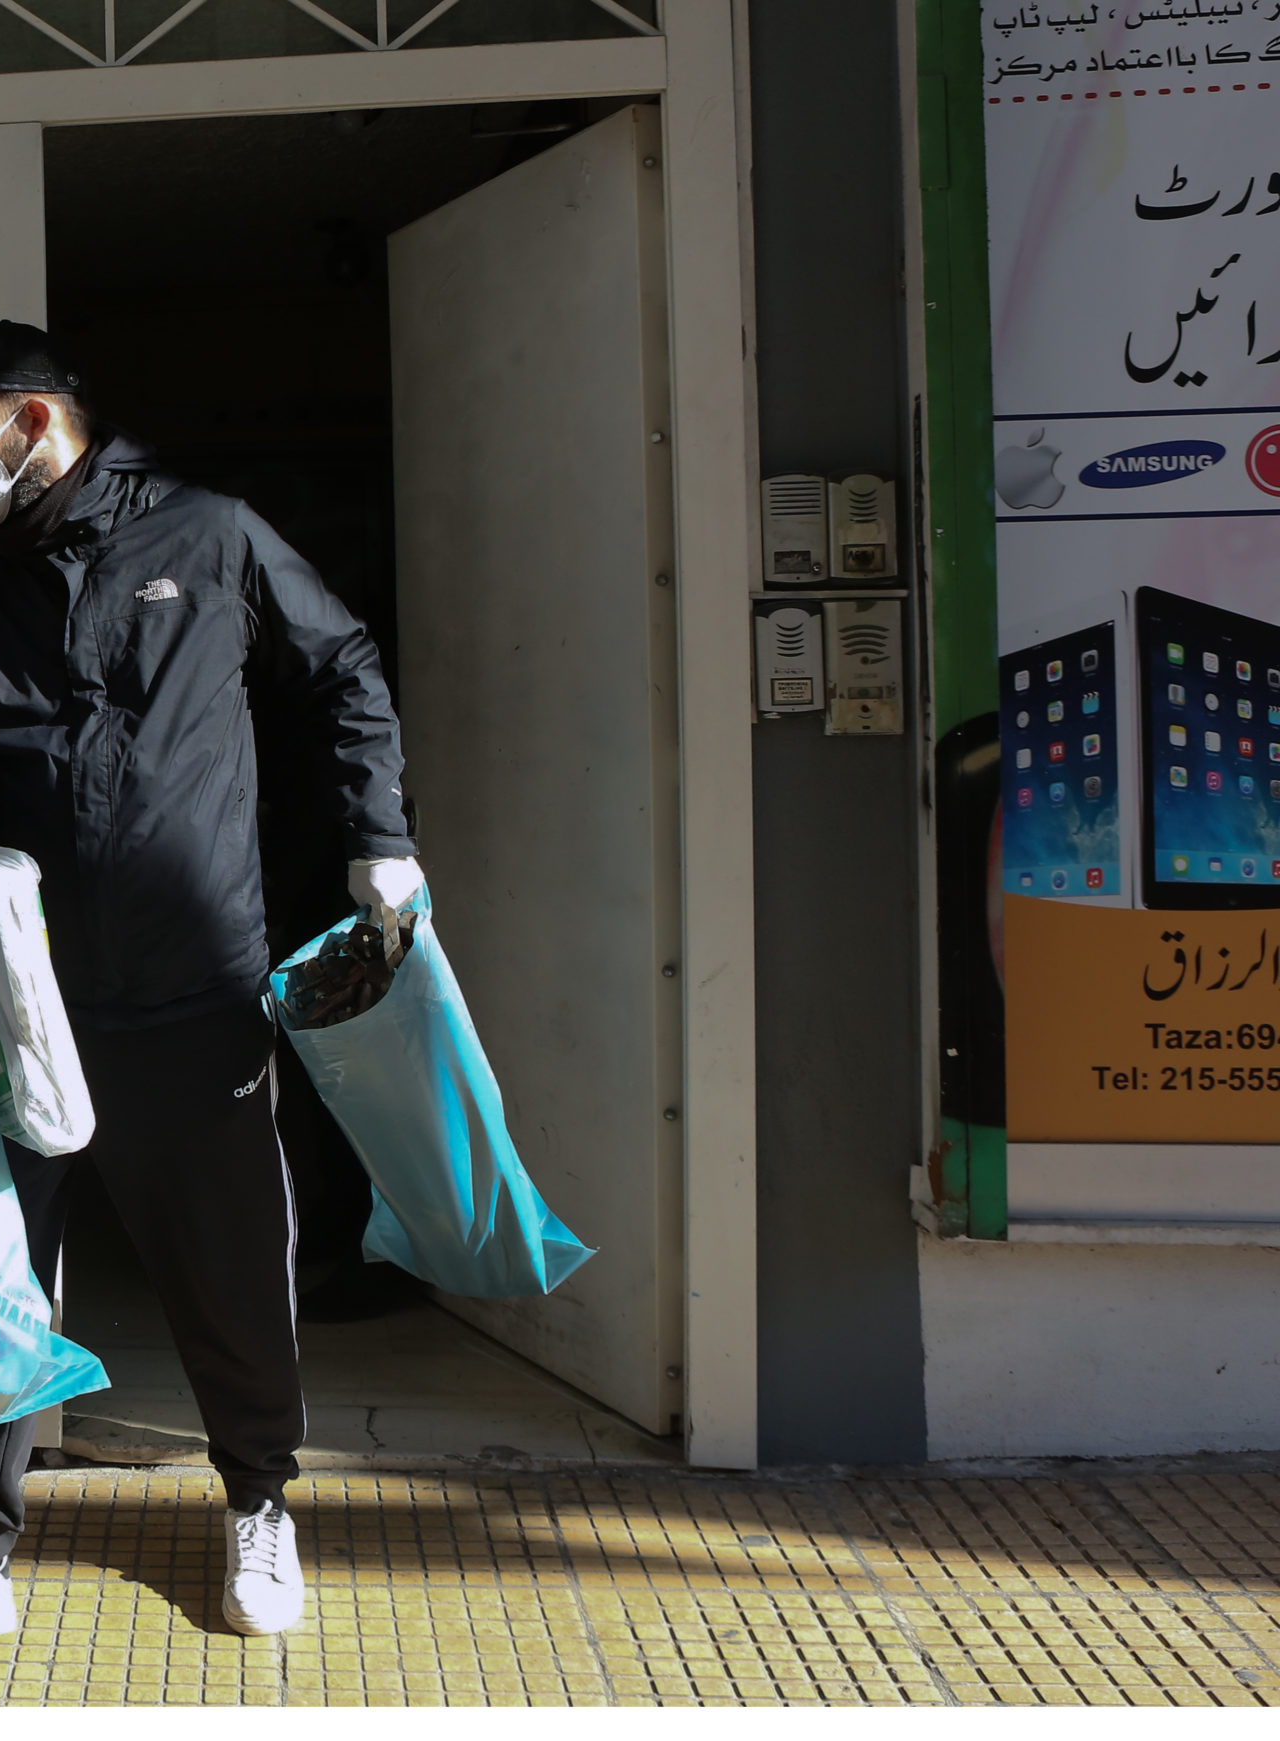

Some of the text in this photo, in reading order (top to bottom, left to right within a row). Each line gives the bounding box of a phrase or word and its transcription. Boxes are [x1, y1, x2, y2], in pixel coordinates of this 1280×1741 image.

[993, 2, 1039, 38] ٹاپ
[1047, 4, 1099, 35] لیپ
[1205, 43, 1251, 65] کا
[987, 56, 1077, 84] مرکز
[1096, 454, 1214, 474] SAMSUNG
[135, 586, 164, 599] NORTH
[145, 579, 162, 589] THE
[144, 593, 164, 603] FACE
[1144, 1023, 1280, 1050] Taza:69
[233, 1065, 267, 1098] adi
[1091, 1066, 1280, 1091] Tel: 215-555
